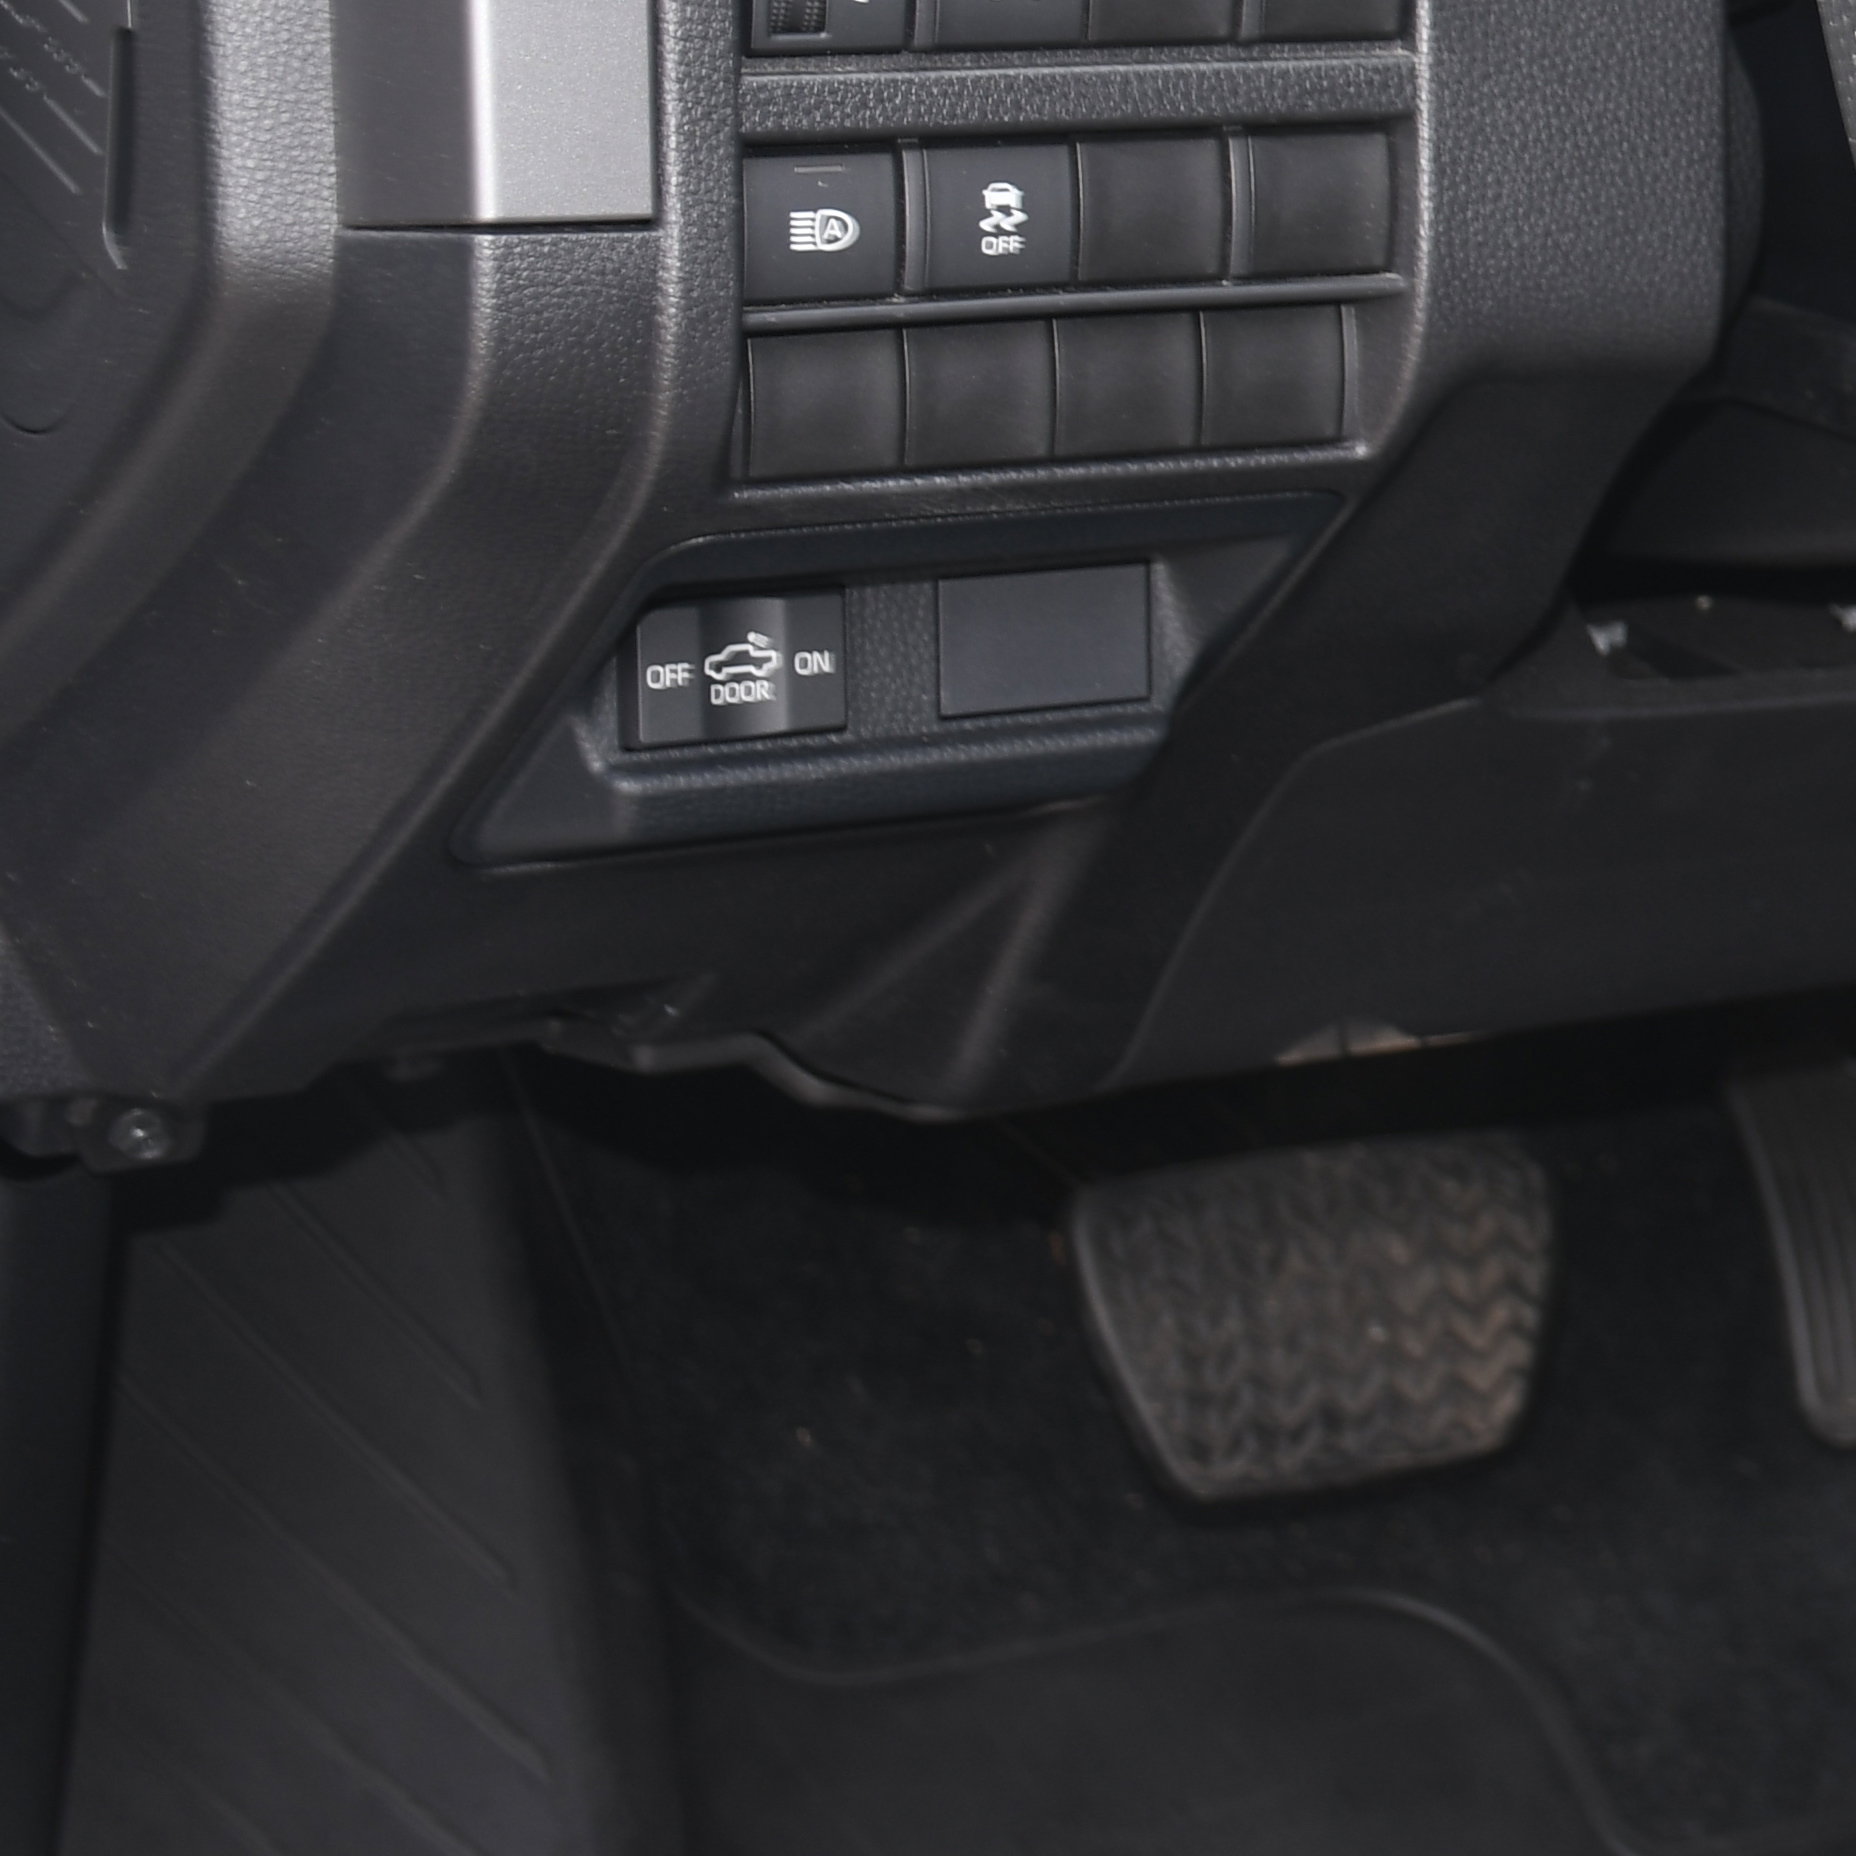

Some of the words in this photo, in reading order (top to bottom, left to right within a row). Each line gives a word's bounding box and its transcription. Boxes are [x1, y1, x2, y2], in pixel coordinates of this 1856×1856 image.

[981, 235, 1026, 256] OFF
[646, 662, 695, 690] OFF
[794, 650, 835, 676] ON
[710, 679, 776, 706] DOOR
